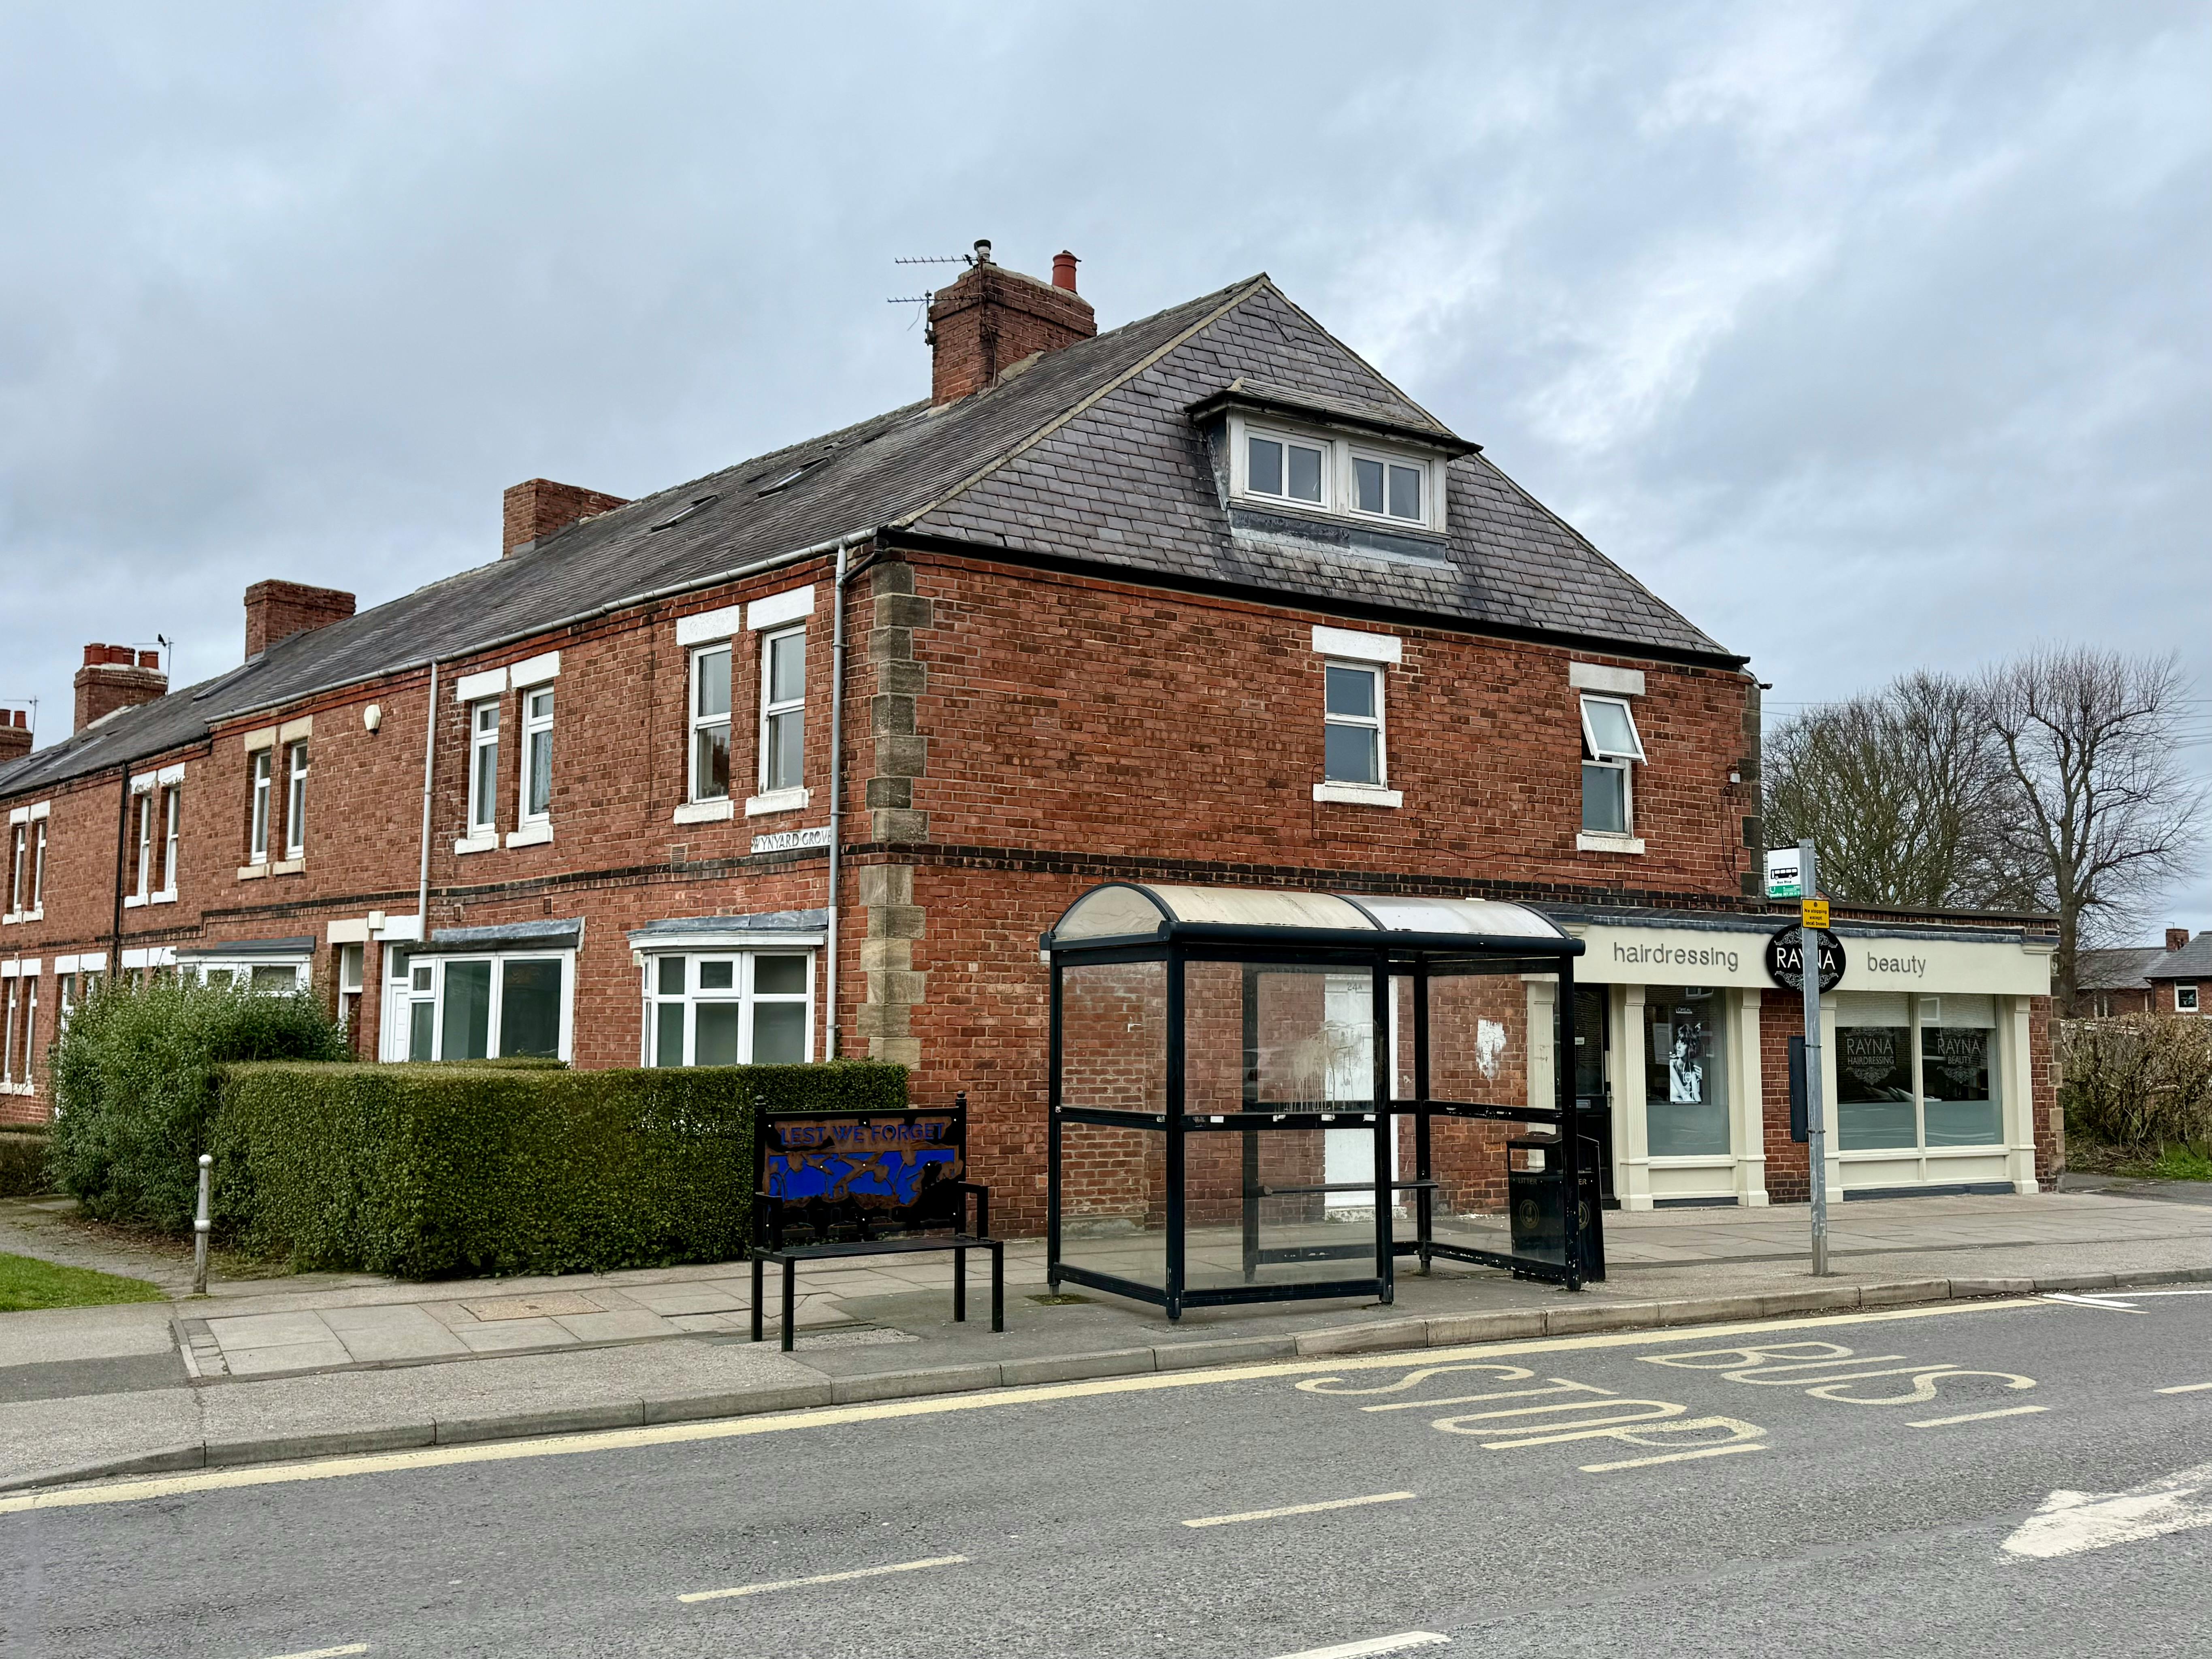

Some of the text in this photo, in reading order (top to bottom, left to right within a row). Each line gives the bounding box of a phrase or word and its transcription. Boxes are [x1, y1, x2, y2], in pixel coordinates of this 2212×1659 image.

[753, 829, 831, 850] WYNYARD GROVE
[1614, 942, 1738, 972] hairdressing
[1777, 947, 1836, 970] RAA
[1867, 951, 1926, 978] beauty
[1347, 982, 1362, 991] 24A
[1847, 1038, 1893, 1055] RAYNA
[1938, 1038, 1981, 1054] RAYNA
[1848, 1056, 1894, 1065] HAIRDRESSING
[1948, 1055, 1972, 1064] BEAUTY
[781, 1122, 945, 1145] LEST WE FORGET
[1634, 1341, 2038, 1405] BUS
[1295, 1364, 1768, 1450] STOP
